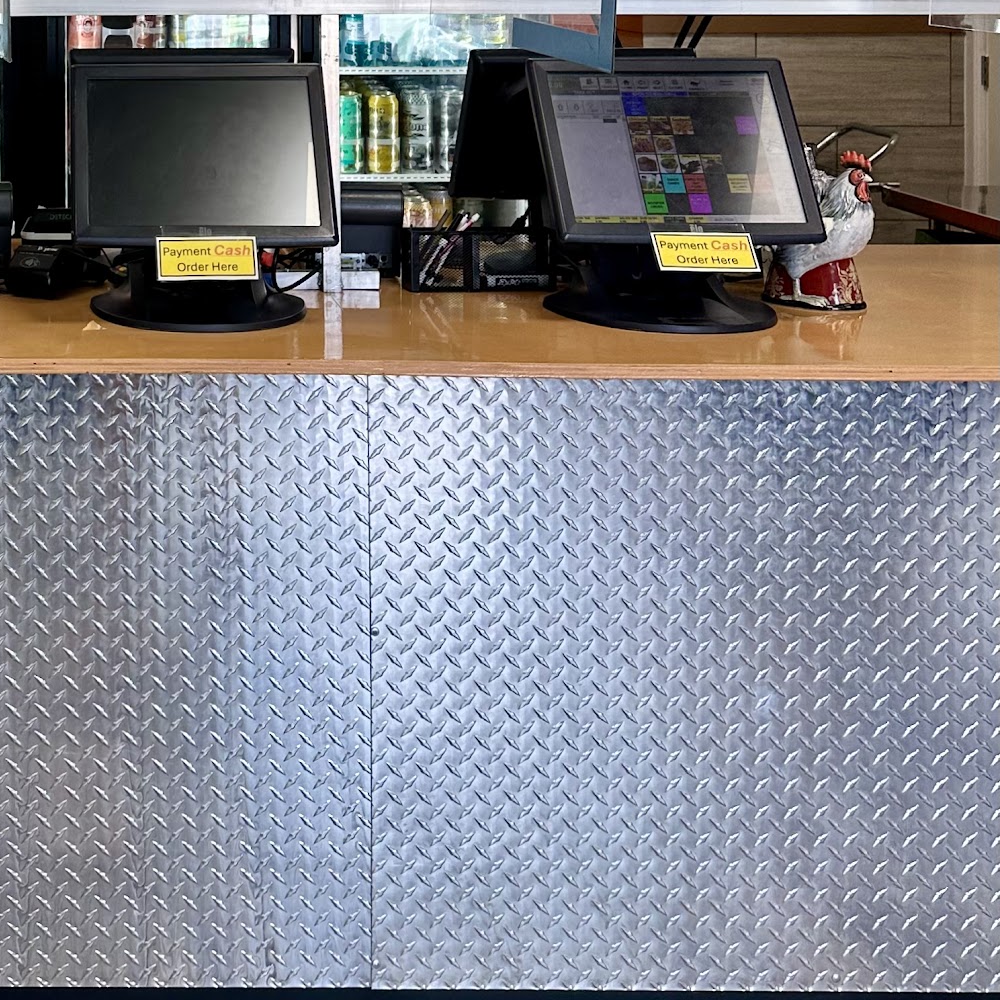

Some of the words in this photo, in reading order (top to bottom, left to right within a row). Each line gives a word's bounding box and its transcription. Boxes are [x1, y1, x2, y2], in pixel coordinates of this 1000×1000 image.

[162, 245, 212, 258] Payment
[214, 244, 251, 257] Cash
[177, 261, 209, 273] Order
[211, 261, 238, 272] Here
